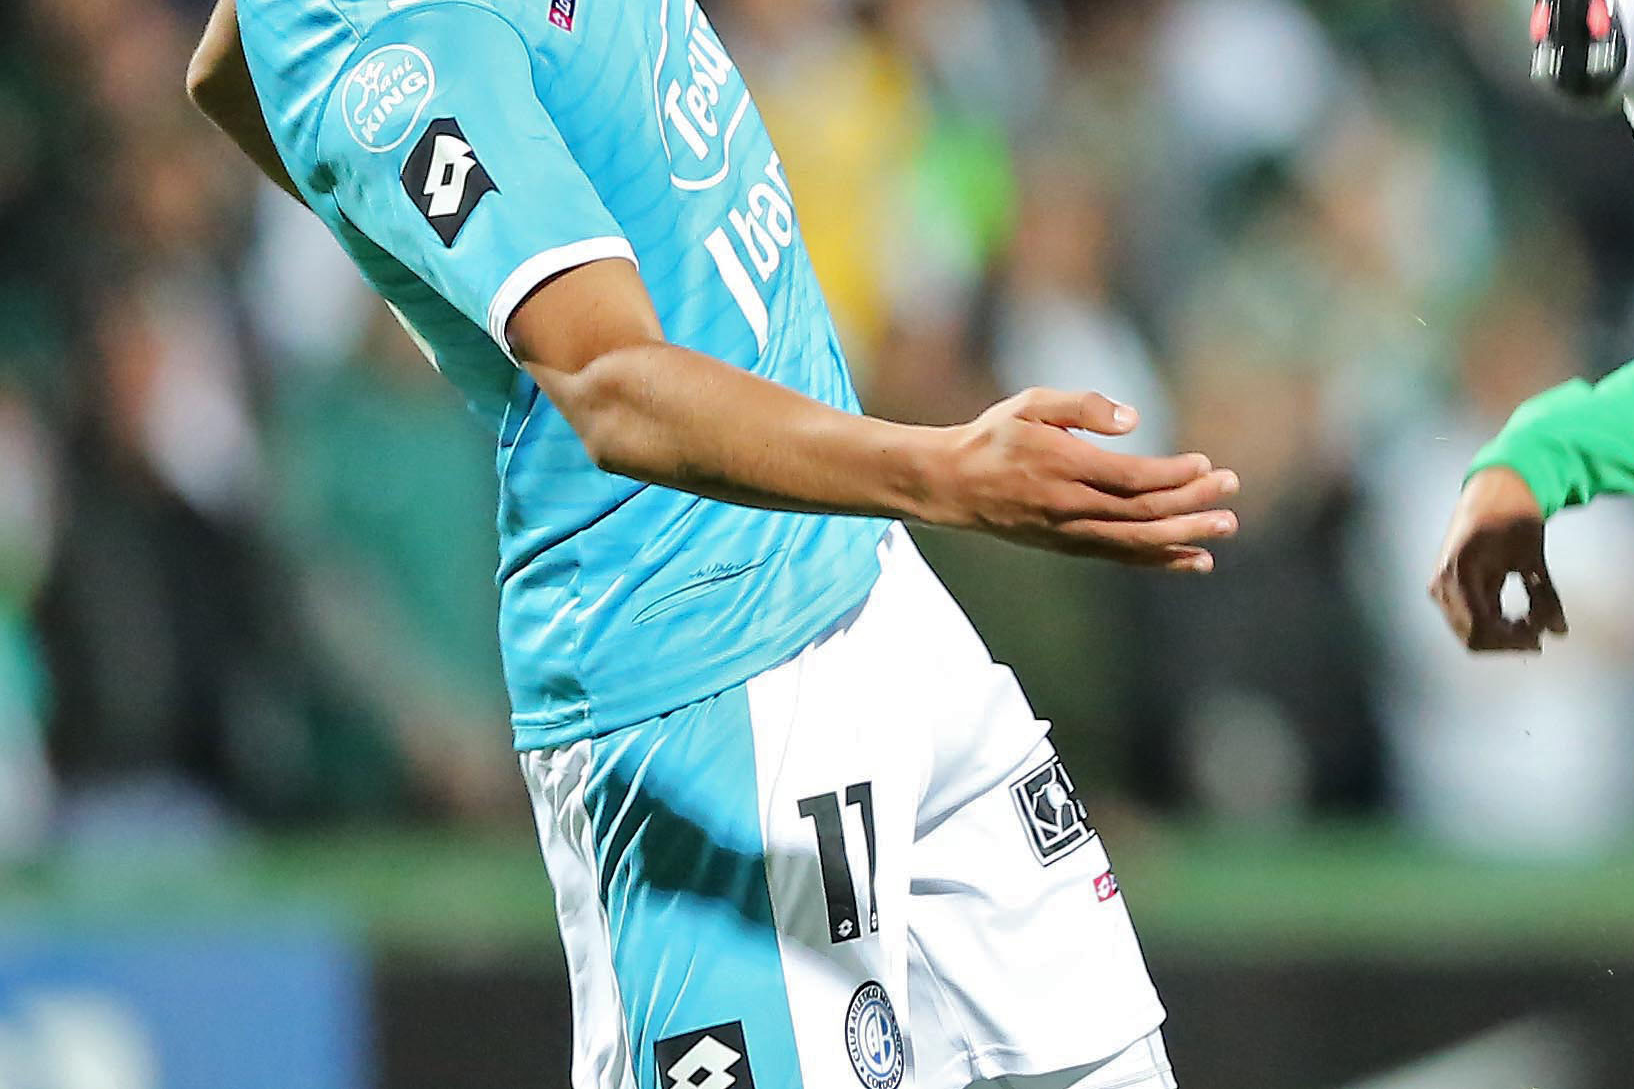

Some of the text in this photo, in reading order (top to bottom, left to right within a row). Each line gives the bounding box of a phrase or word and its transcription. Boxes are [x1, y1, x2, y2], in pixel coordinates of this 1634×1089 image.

[361, 71, 428, 144] KING
[664, 8, 735, 161] Tesu
[797, 780, 879, 944] 11
[849, 1026, 861, 1062] CLUB
